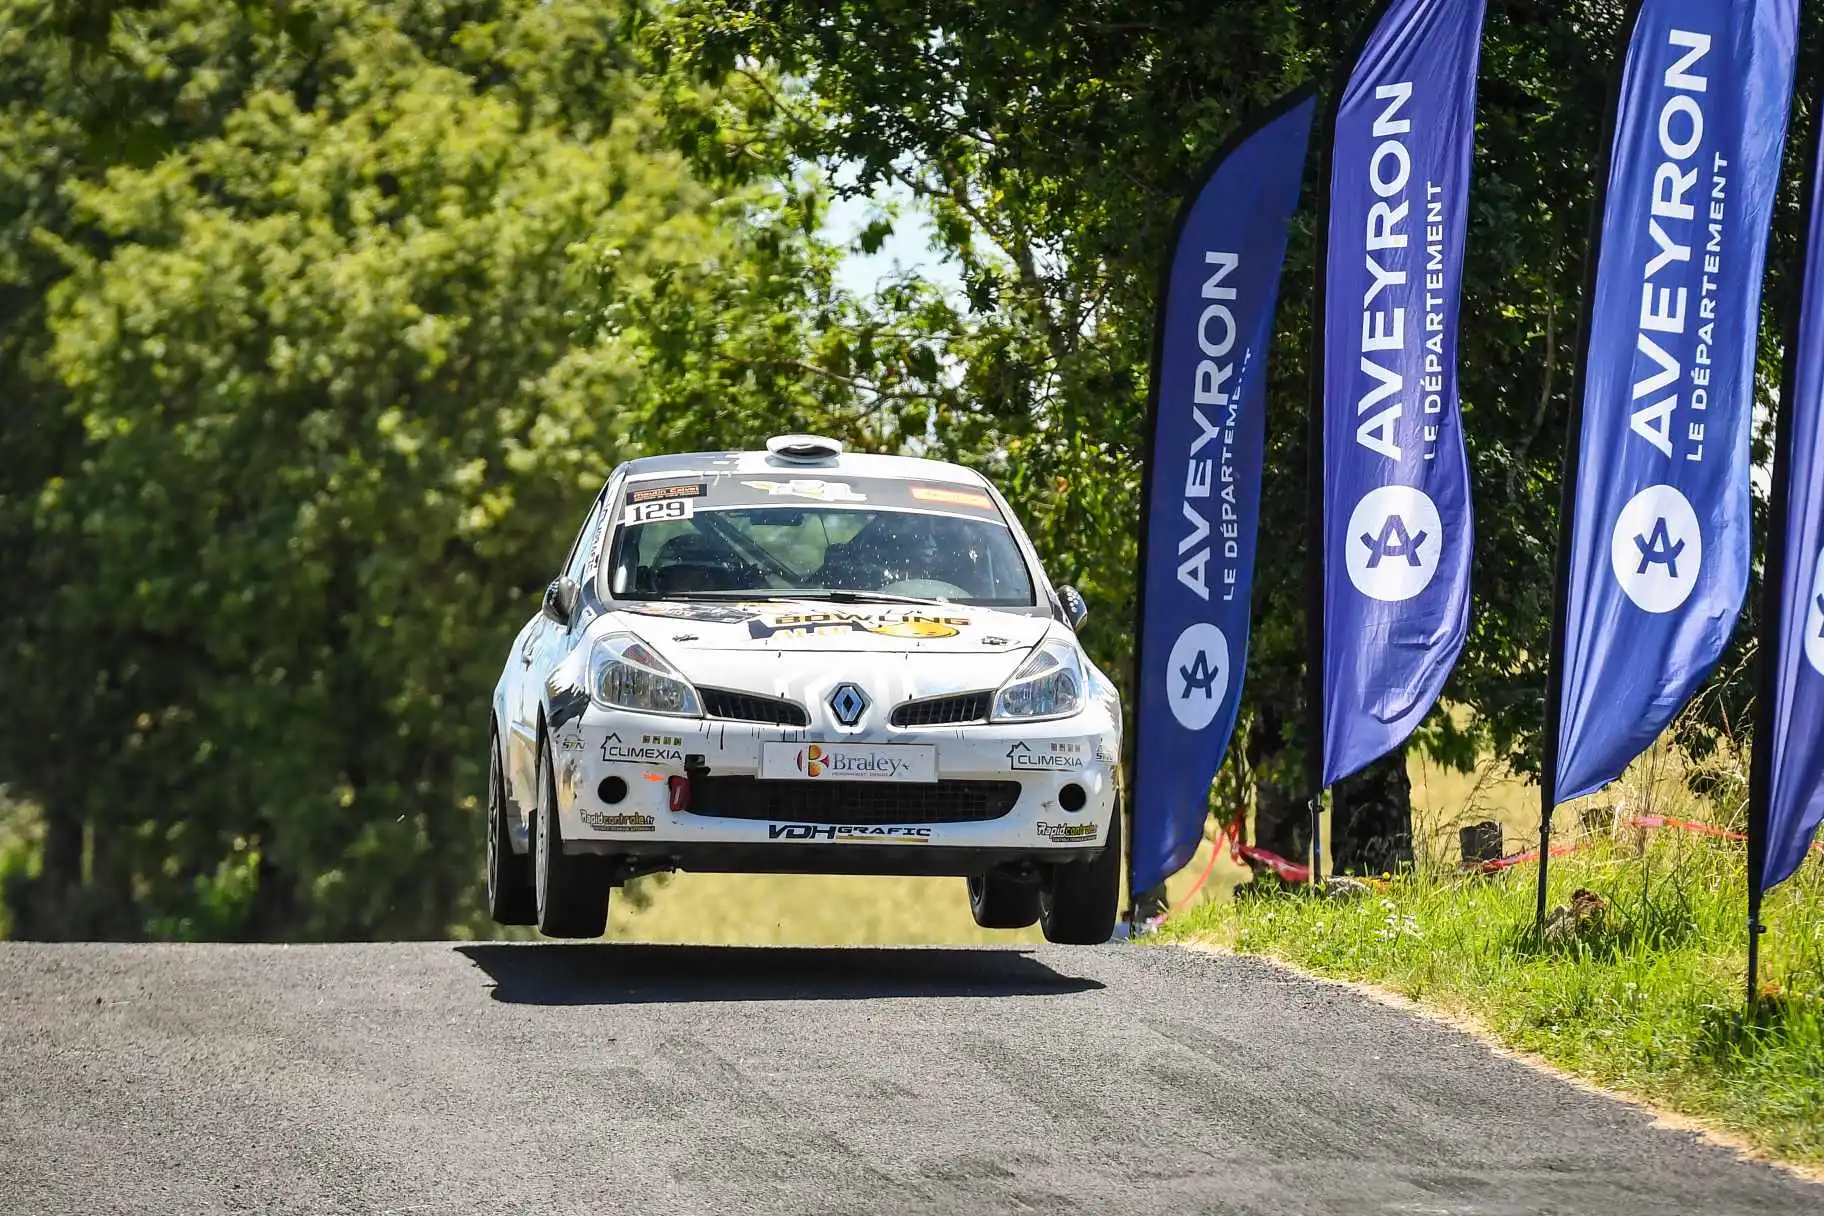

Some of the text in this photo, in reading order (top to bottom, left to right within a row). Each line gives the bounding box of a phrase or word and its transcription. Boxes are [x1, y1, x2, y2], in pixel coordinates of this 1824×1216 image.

[1356, 81, 1413, 461] AVEYRON
[1420, 181, 1444, 460] LE DÉPARTEMENT
[1631, 29, 1711, 458] AVEYRON
[1686, 151, 1728, 461] LE DÉPARTEMENT
[633, 501, 685, 522] 129
[1176, 251, 1240, 601] AVEYRON
[1222, 347, 1252, 601] LE DÉPARTEMET
[609, 746, 682, 760] CLIMEXIA
[832, 752, 902, 777] Braley
[1017, 754, 1084, 767] CLIMEXIA
